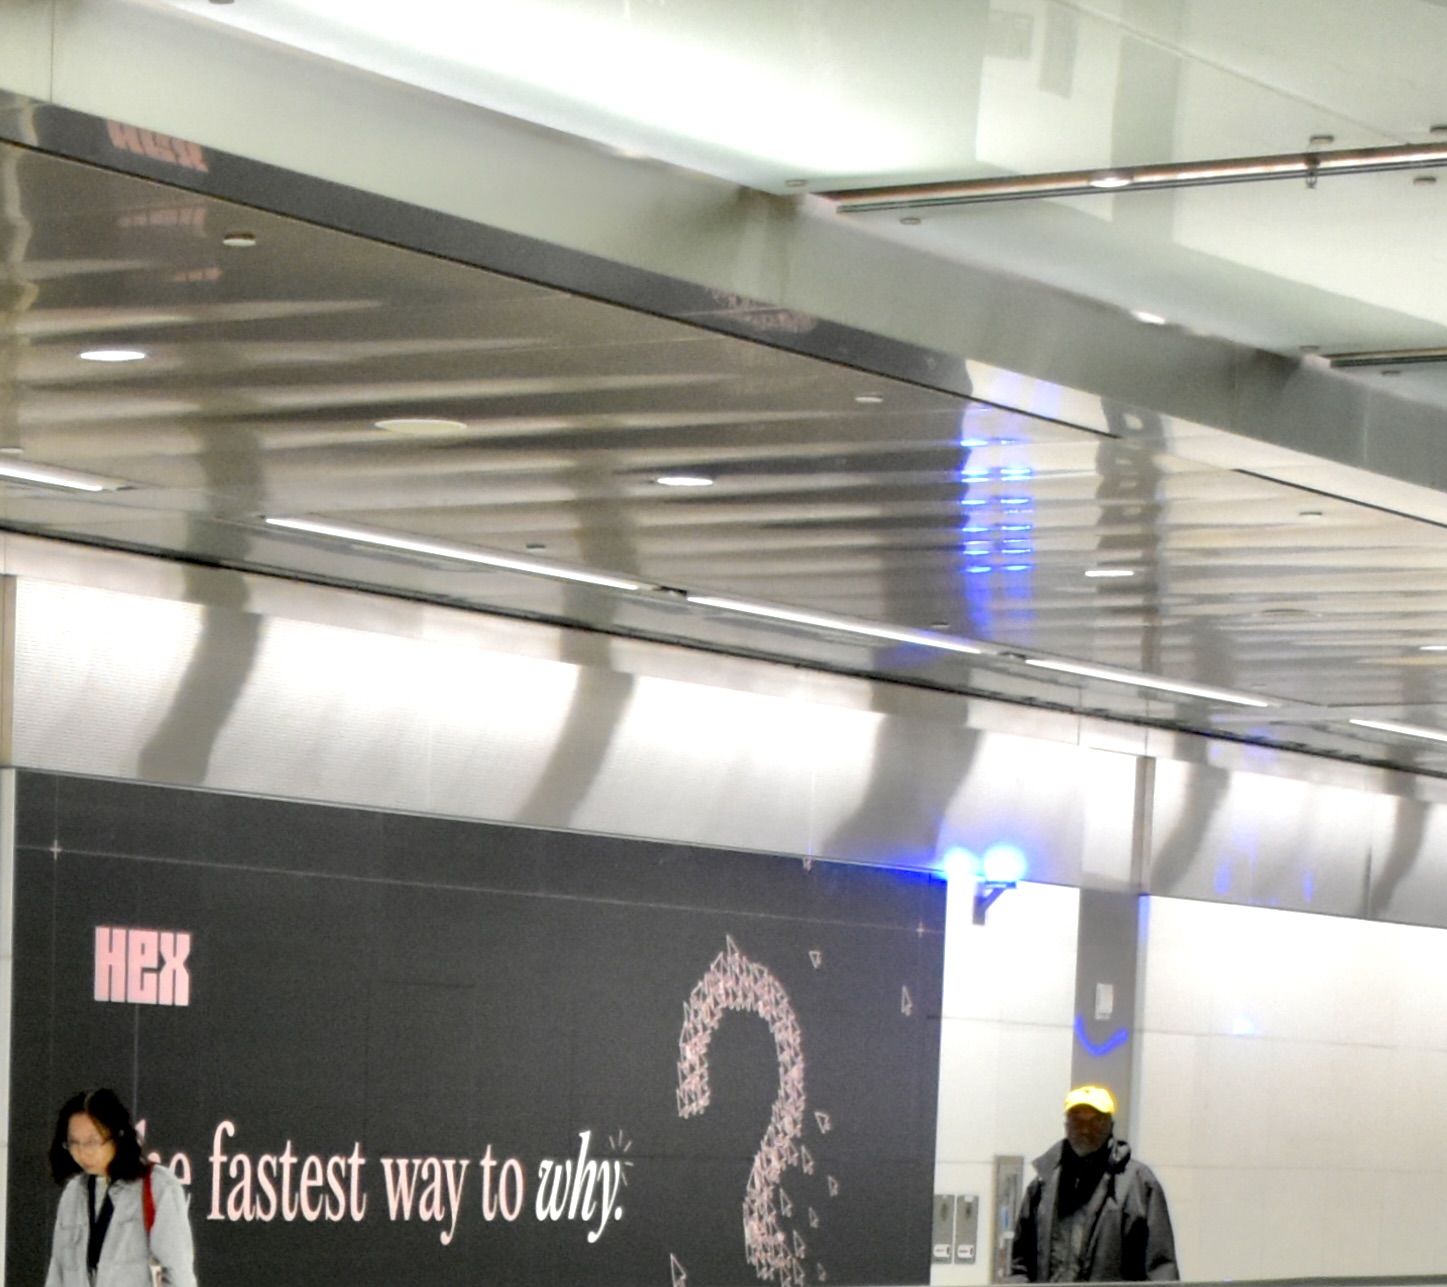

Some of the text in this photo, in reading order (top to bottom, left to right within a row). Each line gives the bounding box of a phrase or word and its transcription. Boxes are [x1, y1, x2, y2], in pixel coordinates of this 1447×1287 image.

[207, 1121, 366, 1221] fastest
[381, 1157, 470, 1245] way
[480, 1145, 524, 1221] to
[536, 1130, 622, 1243] why.
